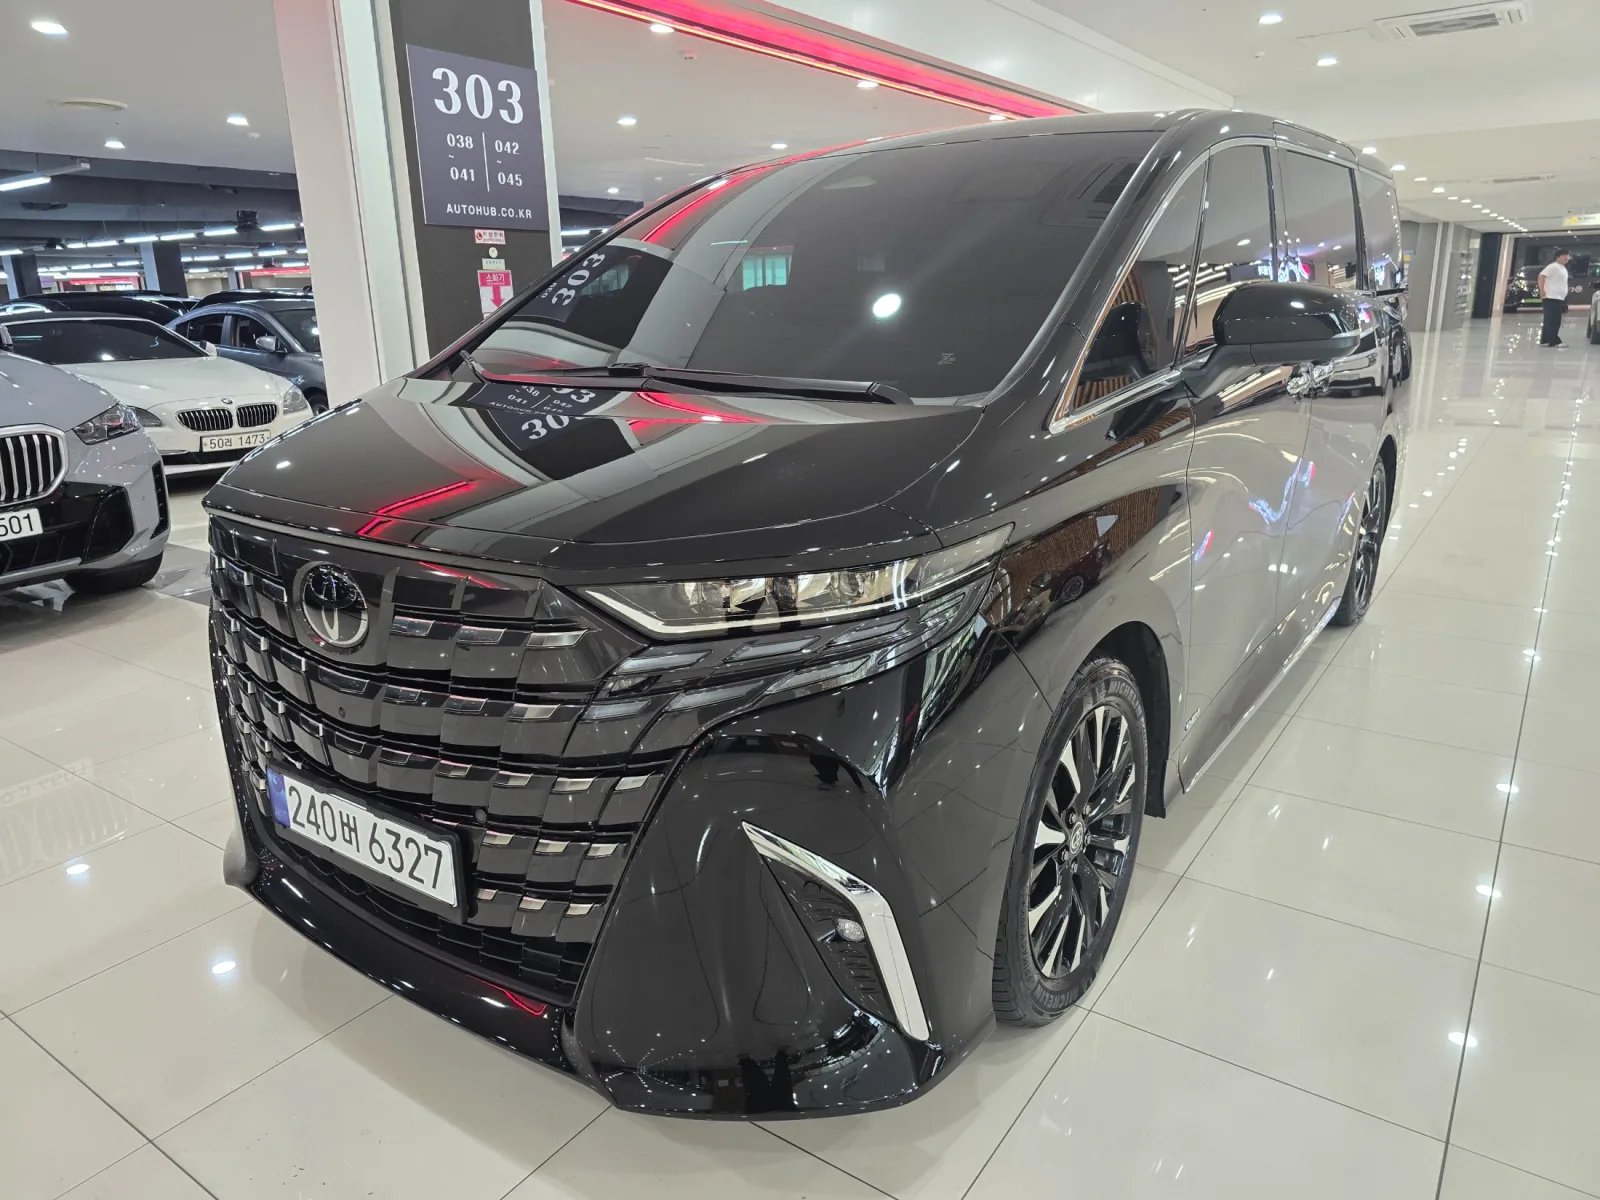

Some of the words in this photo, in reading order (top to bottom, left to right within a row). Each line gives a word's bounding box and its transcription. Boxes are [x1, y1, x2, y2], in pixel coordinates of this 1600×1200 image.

[432, 67, 524, 125] 303
[446, 133, 474, 149] 038
[495, 139, 520, 155] 042
[450, 166, 475, 182] 041
[498, 172, 523, 186] 045
[446, 203, 532, 219] AUTOHUB.CO.KR
[485, 273, 505, 282] 소화기
[239, 433, 265, 446] 1473
[0, 513, 34, 537] 501
[1108, 680, 1143, 718] MICHELIN
[288, 785, 361, 853] 240버
[368, 822, 443, 890] 6327
[1033, 984, 1080, 1009] MICHELIN
